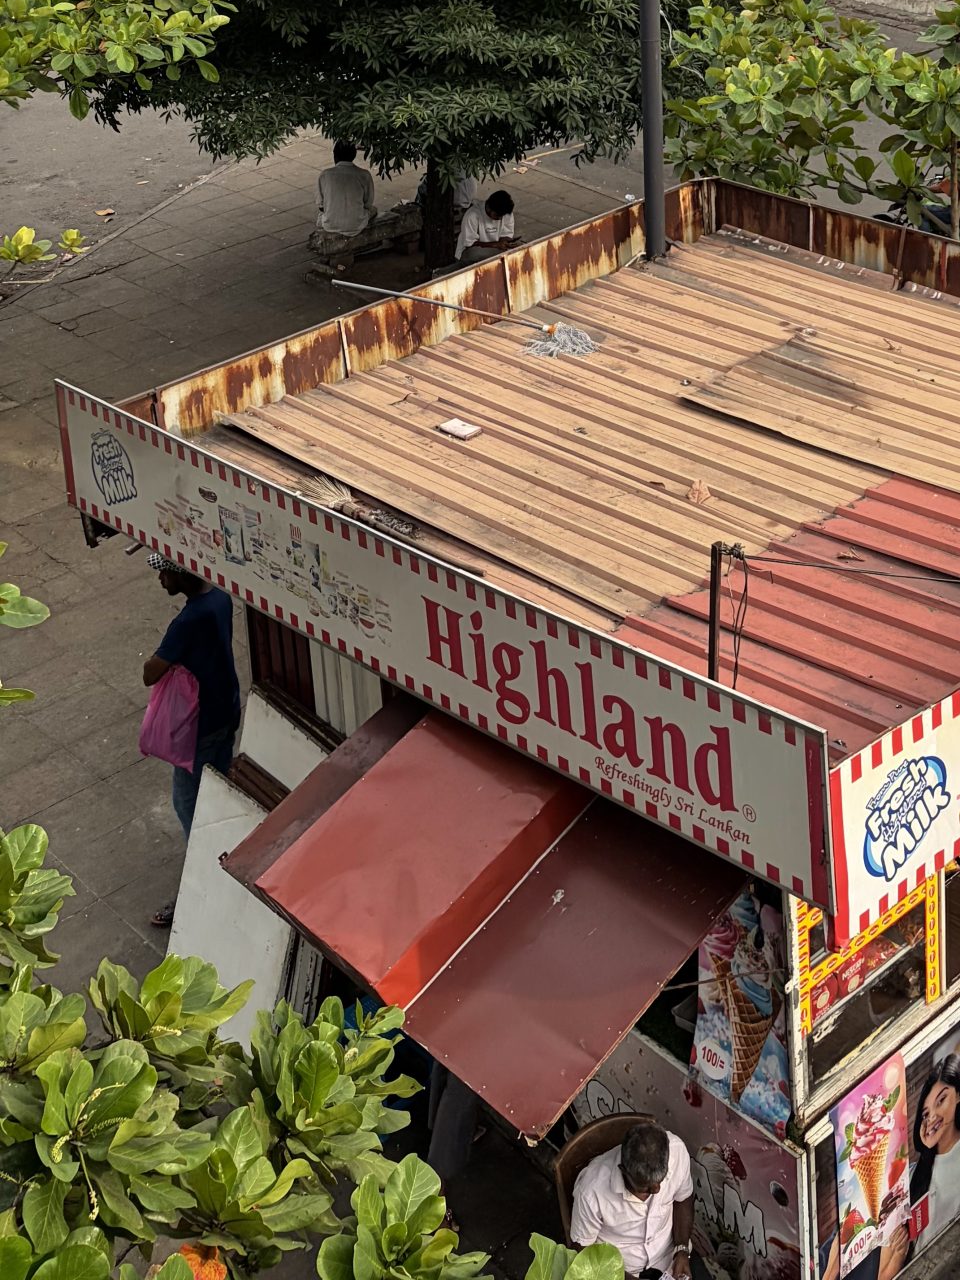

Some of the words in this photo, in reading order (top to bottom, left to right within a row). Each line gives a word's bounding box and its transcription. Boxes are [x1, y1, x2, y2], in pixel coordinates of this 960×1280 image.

[91, 434, 123, 466] Fresh
[101, 466, 138, 506] Milk
[421, 595, 740, 813] Highland
[594, 755, 673, 808] Refreshingly
[674, 796, 695, 817] Sri
[696, 808, 752, 846] Lankan
[865, 756, 929, 842] Fresh
[881, 783, 952, 883] Milk
[701, 1045, 725, 1070] 100/=
